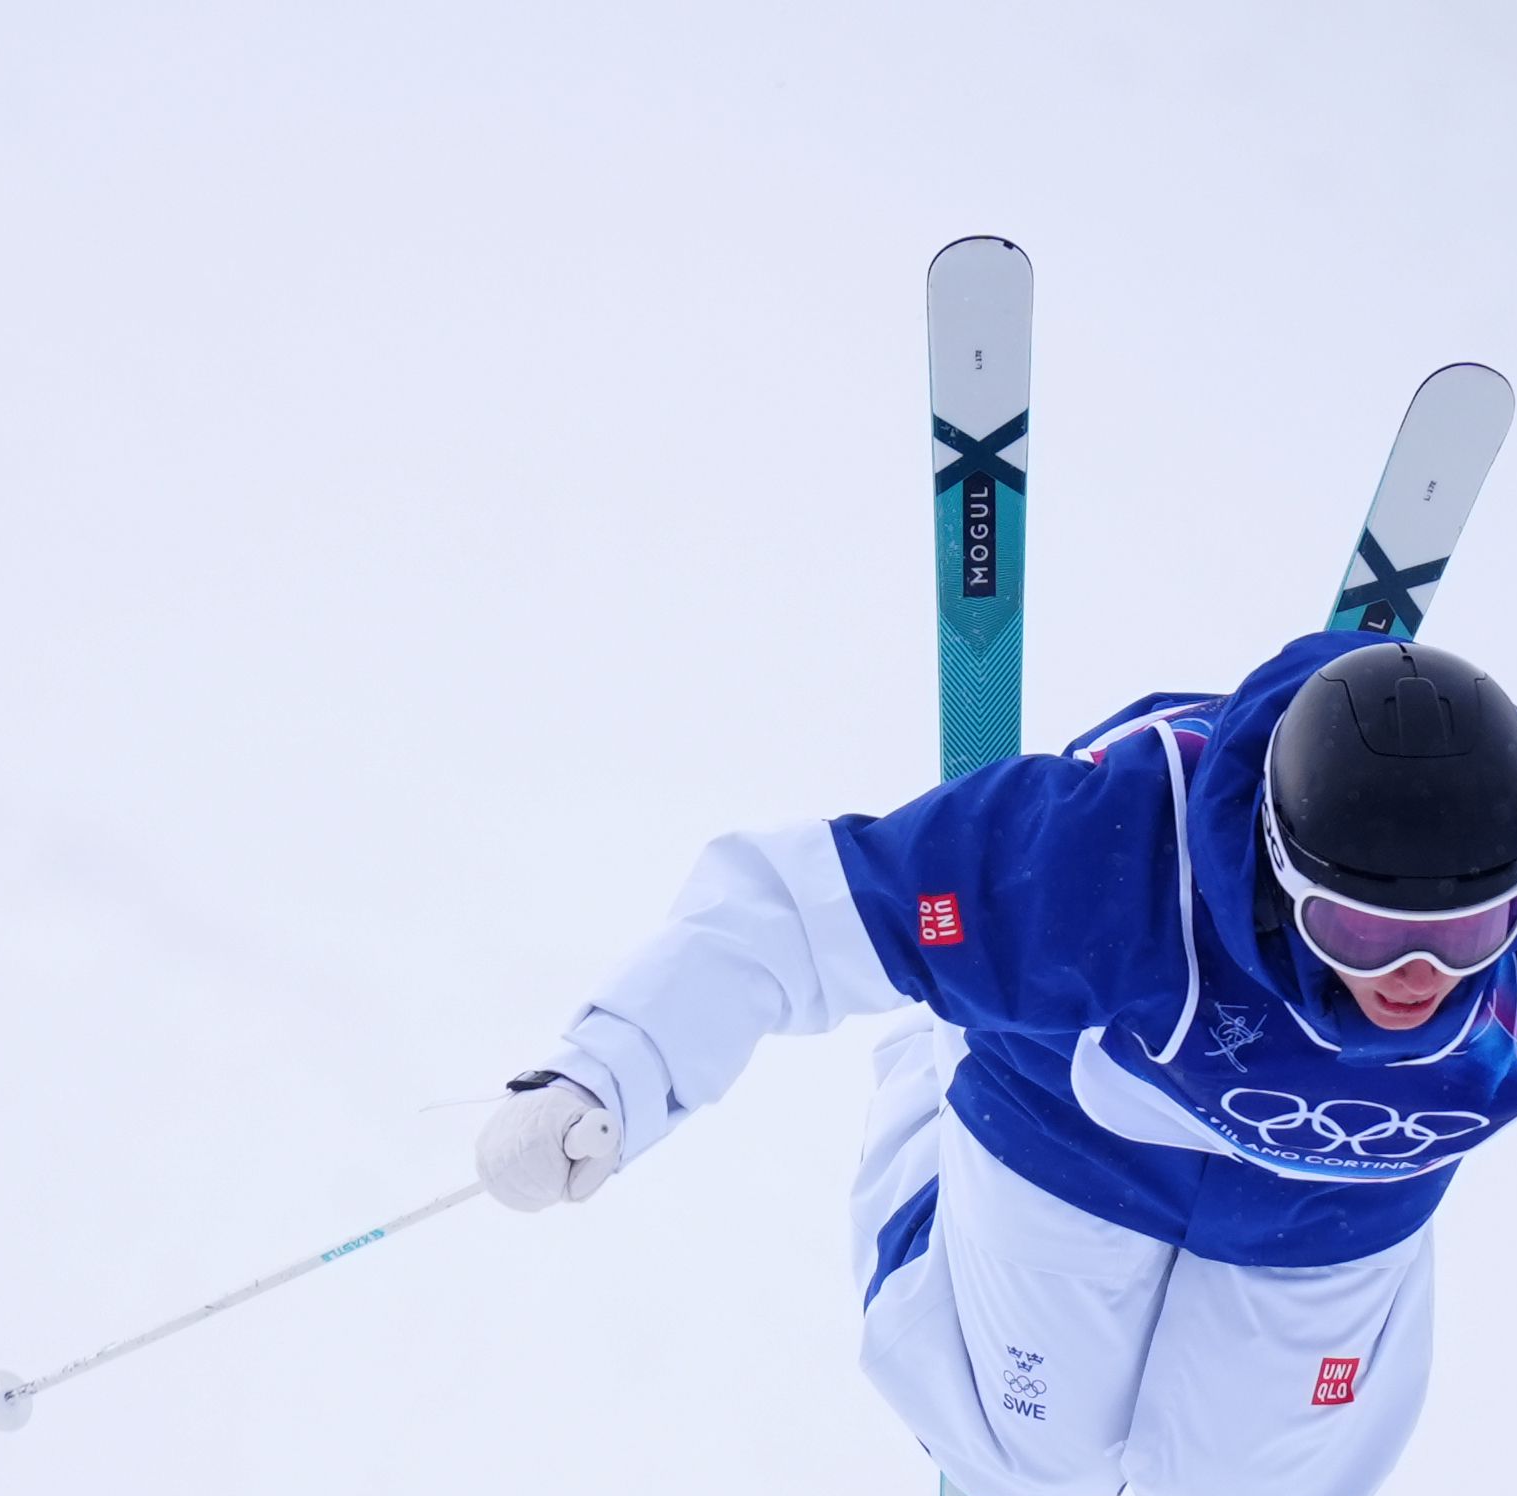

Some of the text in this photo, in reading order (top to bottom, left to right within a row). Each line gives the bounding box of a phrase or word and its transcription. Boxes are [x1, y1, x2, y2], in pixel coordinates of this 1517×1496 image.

[970, 486, 989, 586] MOGUL
[919, 900, 937, 940] QLO
[934, 899, 958, 937] UNI
[1304, 1155, 1420, 1170] CORTINA
[1322, 1363, 1353, 1380] UNI
[1316, 1382, 1348, 1403] QLO
[1003, 1393, 1047, 1421] SWE
